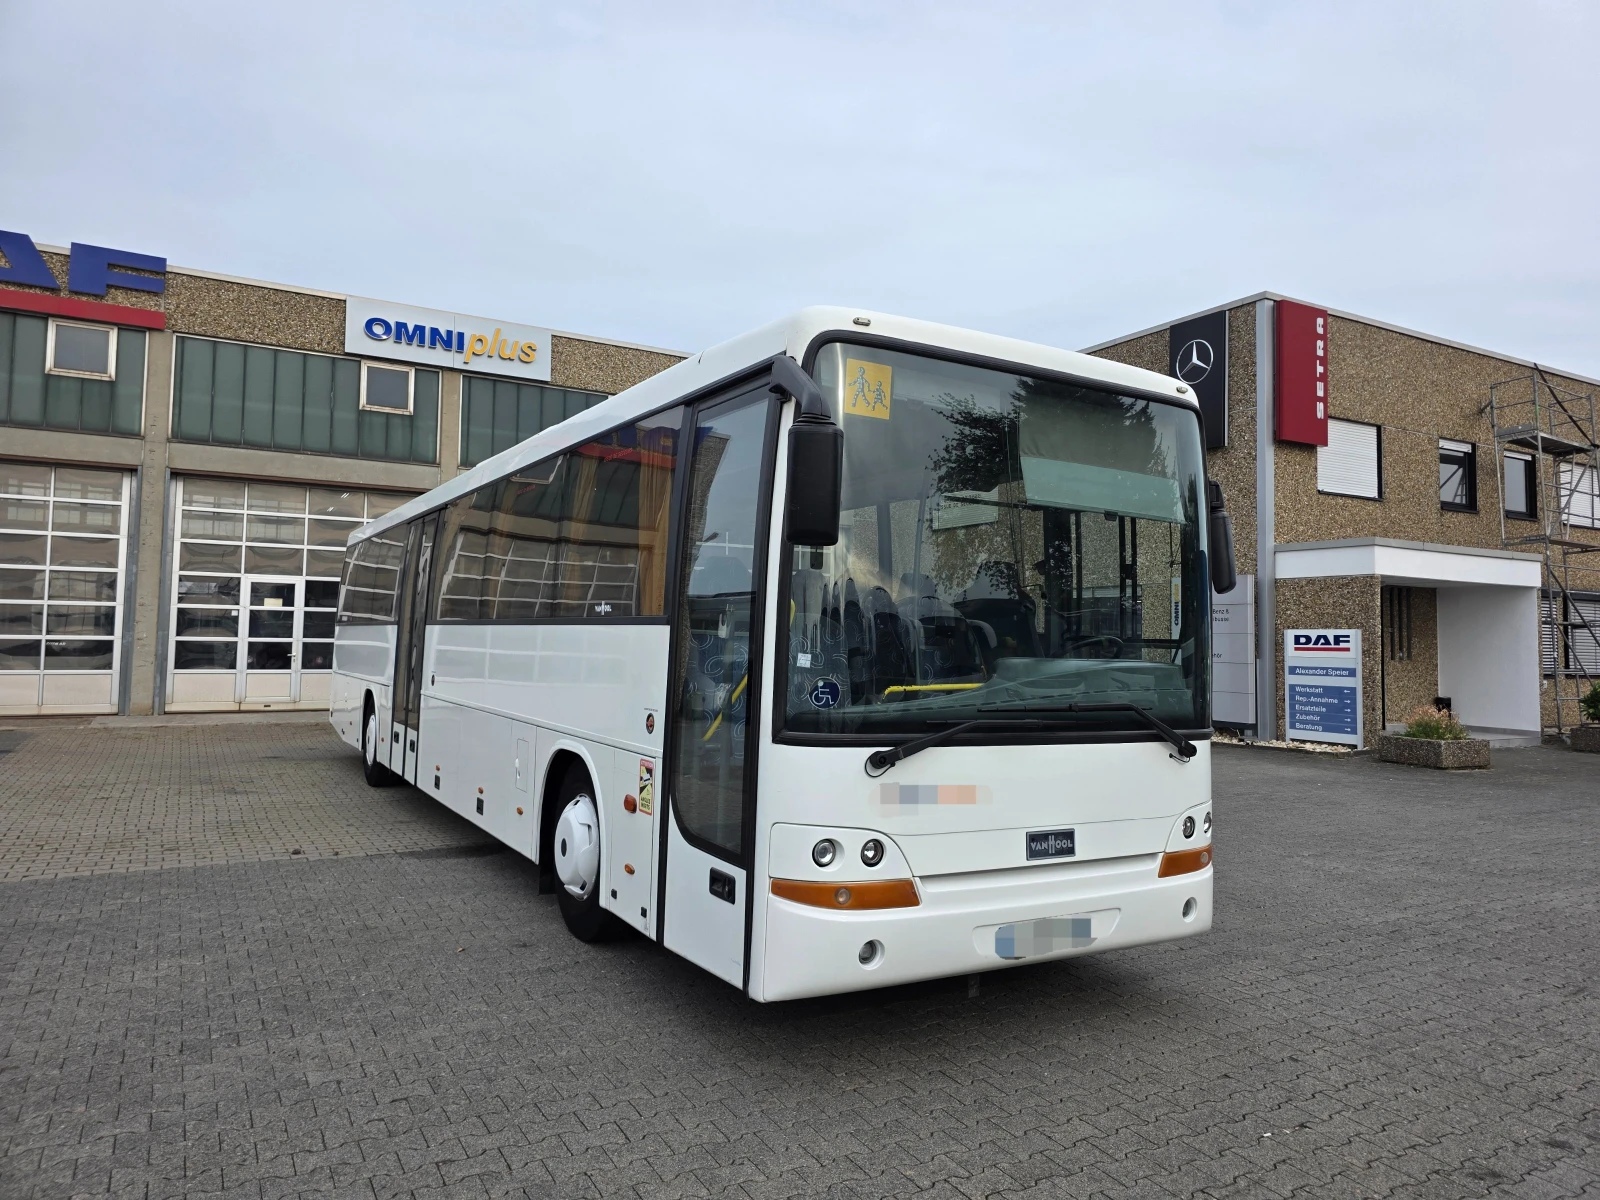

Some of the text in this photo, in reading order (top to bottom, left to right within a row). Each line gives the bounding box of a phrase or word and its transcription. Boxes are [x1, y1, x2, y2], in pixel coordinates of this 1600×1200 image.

[0, 230, 167, 296] AF
[1316, 317, 1324, 419] SETRA
[1294, 634, 1351, 646] DAF
[1295, 667, 1349, 676] Alexander Speier
[1295, 686, 1323, 694] Werkstatt
[1295, 695, 1338, 704] Rep.-Annahme
[1295, 704, 1327, 712] Ersatzteile
[1295, 713, 1321, 721] Zubehör
[1295, 722, 1323, 731] Beratung
